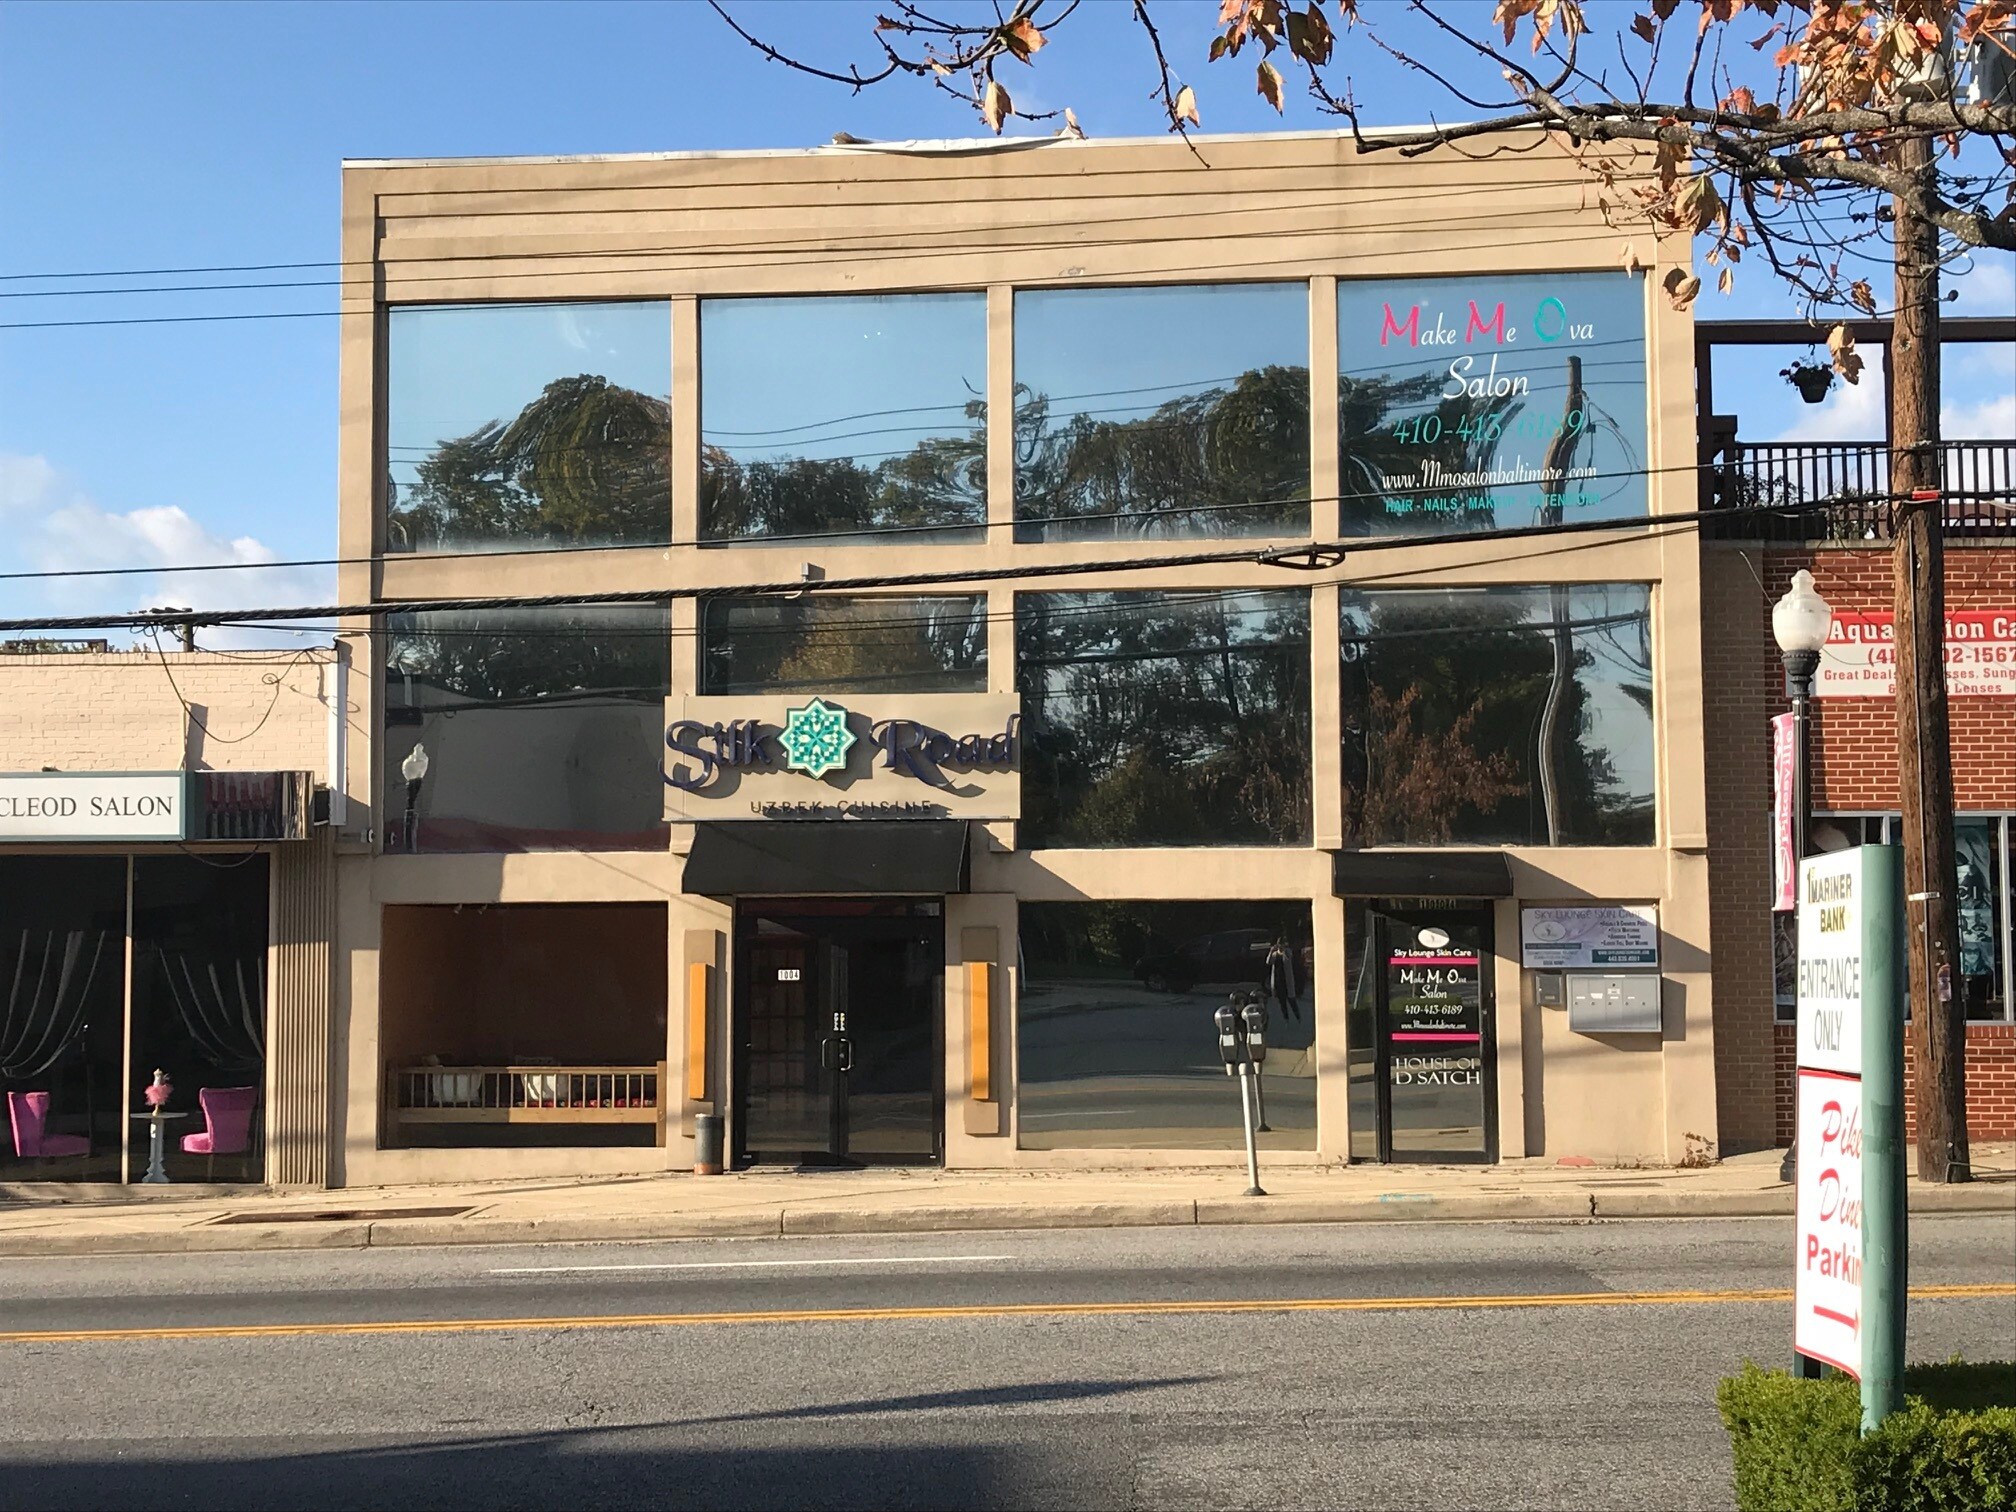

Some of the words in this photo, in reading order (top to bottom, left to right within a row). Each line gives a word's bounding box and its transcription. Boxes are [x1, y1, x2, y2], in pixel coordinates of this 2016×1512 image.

[1380, 302, 1457, 347] Make
[1465, 300, 1517, 345] Me
[1533, 296, 1595, 343] Ova
[1443, 353, 1530, 400] Salon
[1382, 455, 1598, 489] www.Mmosalonbaltimore.com
[1385, 498, 1414, 513] HAIR
[1423, 497, 1458, 512] NAILS
[1829, 619, 1895, 645] Aqua
[1824, 669, 1859, 681] Great
[1954, 682, 2002, 694] Lenses
[658, 719, 772, 791] Silk
[868, 713, 1021, 787] Road
[1780, 728, 1793, 843] Pikesville
[90, 796, 172, 817] SALON
[750, 801, 822, 814] UZBEK
[837, 800, 931, 814] CUISINE
[1811, 873, 1852, 903] MARINER
[1820, 905, 1845, 932] BANK
[1394, 949, 1407, 958] Sky
[1409, 949, 1435, 958] Lounge
[780, 970, 799, 979] 1004
[1400, 969, 1425, 984] Make
[1427, 969, 1443, 984] Me
[1800, 957, 1859, 999] ENTRANCE
[1420, 984, 1447, 999] Salon
[1405, 1004, 1463, 1015] 410-413-6189
[1814, 1009, 1843, 1051] ONLY
[1395, 1058, 1453, 1070] HOUSE
[1417, 1071, 1480, 1085] SATCH
